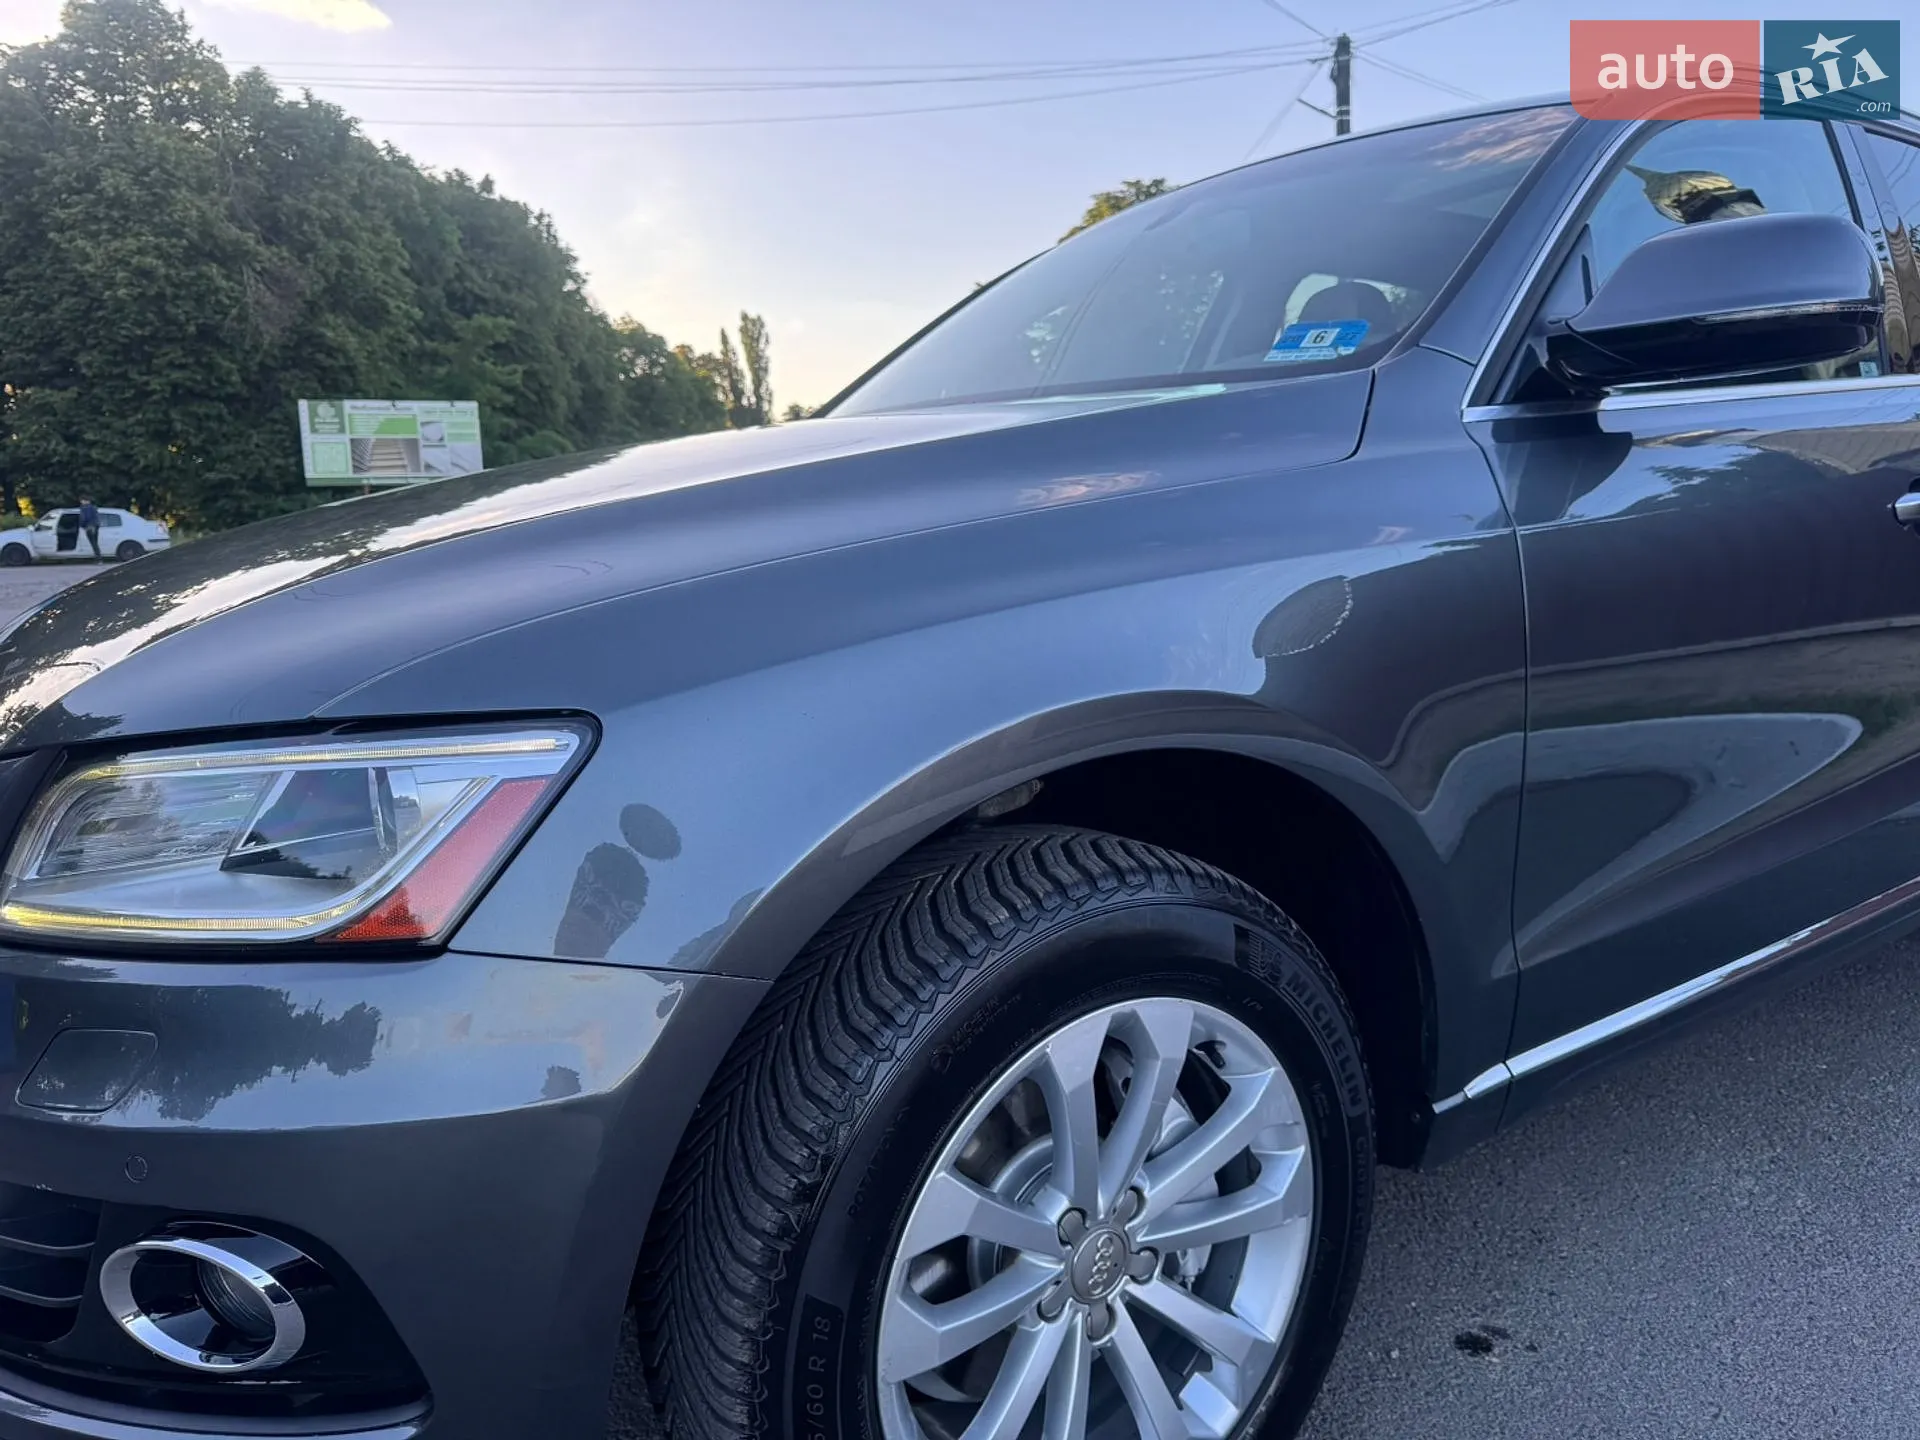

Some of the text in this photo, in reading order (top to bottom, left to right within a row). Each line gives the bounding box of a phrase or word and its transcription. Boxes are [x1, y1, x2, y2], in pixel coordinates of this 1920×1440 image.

[1312, 330, 1328, 344] 6
[1283, 972, 1362, 1107] MICHELIN
[812, 1316, 831, 1341] 18
[808, 1355, 827, 1373] R
